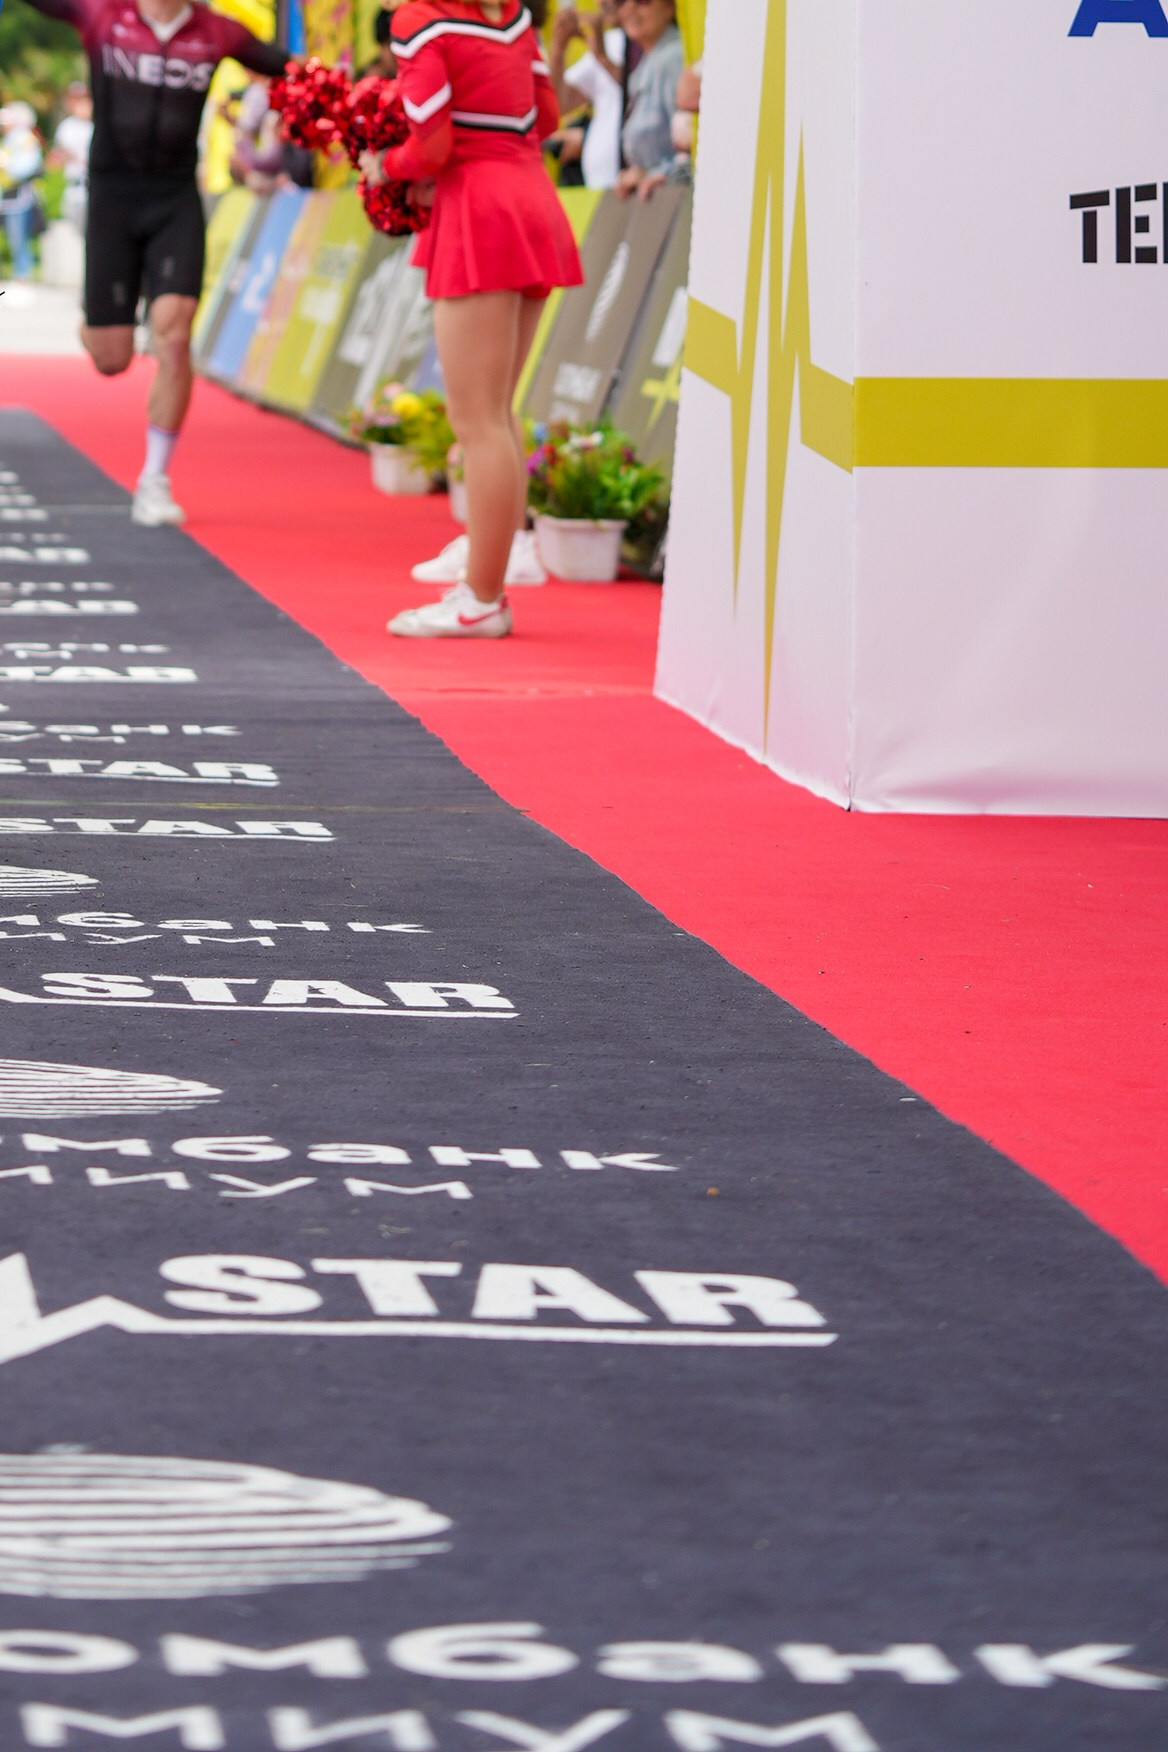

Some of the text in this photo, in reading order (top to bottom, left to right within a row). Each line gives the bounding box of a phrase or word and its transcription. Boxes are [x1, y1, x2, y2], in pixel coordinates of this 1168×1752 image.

[101, 44, 217, 92] INEOS
[1069, 182, 1168, 264] TE
[40, 971, 516, 1009] STAR
[158, 1253, 829, 1327] STAR
